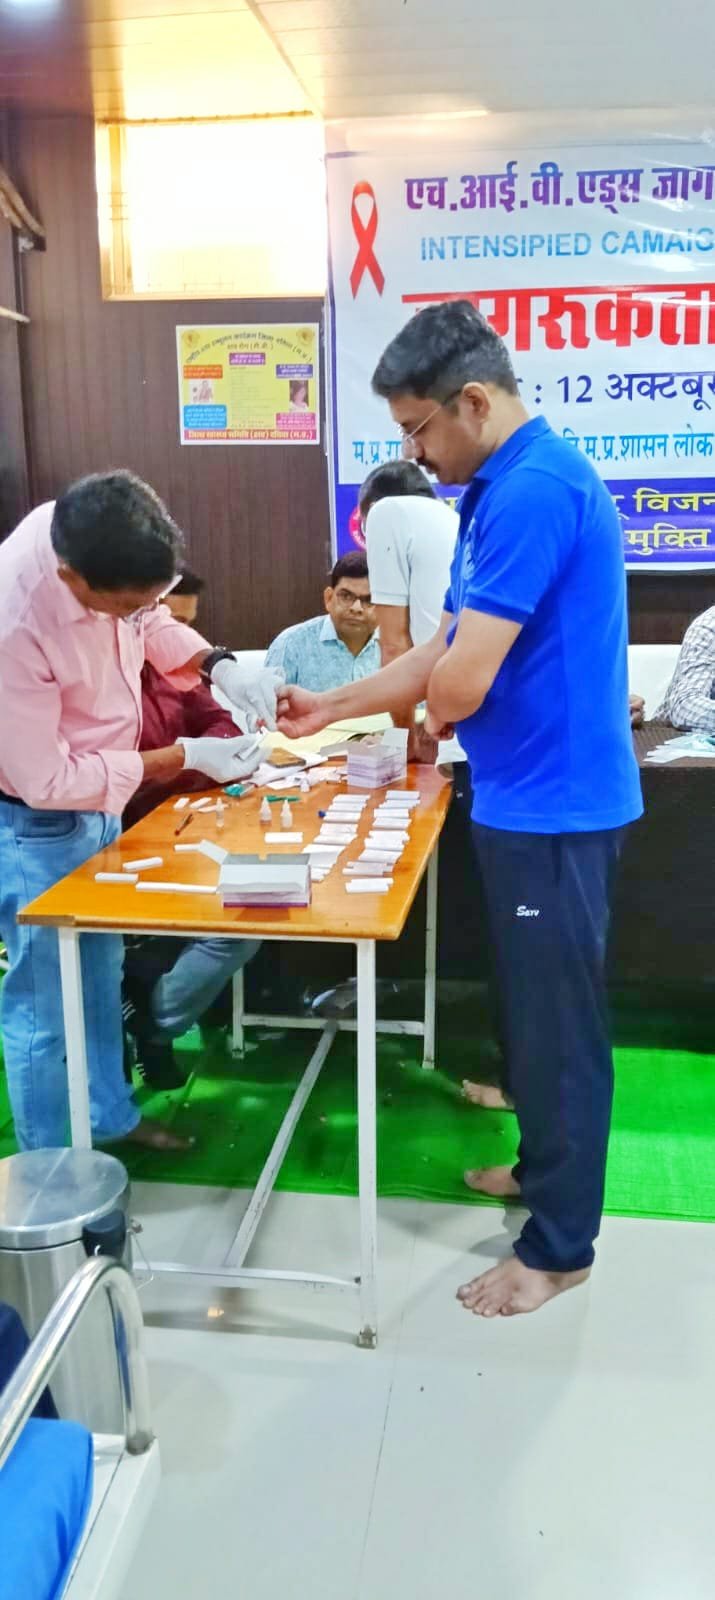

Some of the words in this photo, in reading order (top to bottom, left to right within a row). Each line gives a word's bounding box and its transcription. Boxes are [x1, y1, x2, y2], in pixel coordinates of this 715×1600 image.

[405, 161, 644, 214] एच.आई.वी.एड्स
[421, 233, 592, 262] INTENSIPIED
[557, 374, 593, 403] 12
[672, 424, 714, 459] लोक
[623, 522, 713, 556] मुक्ति
